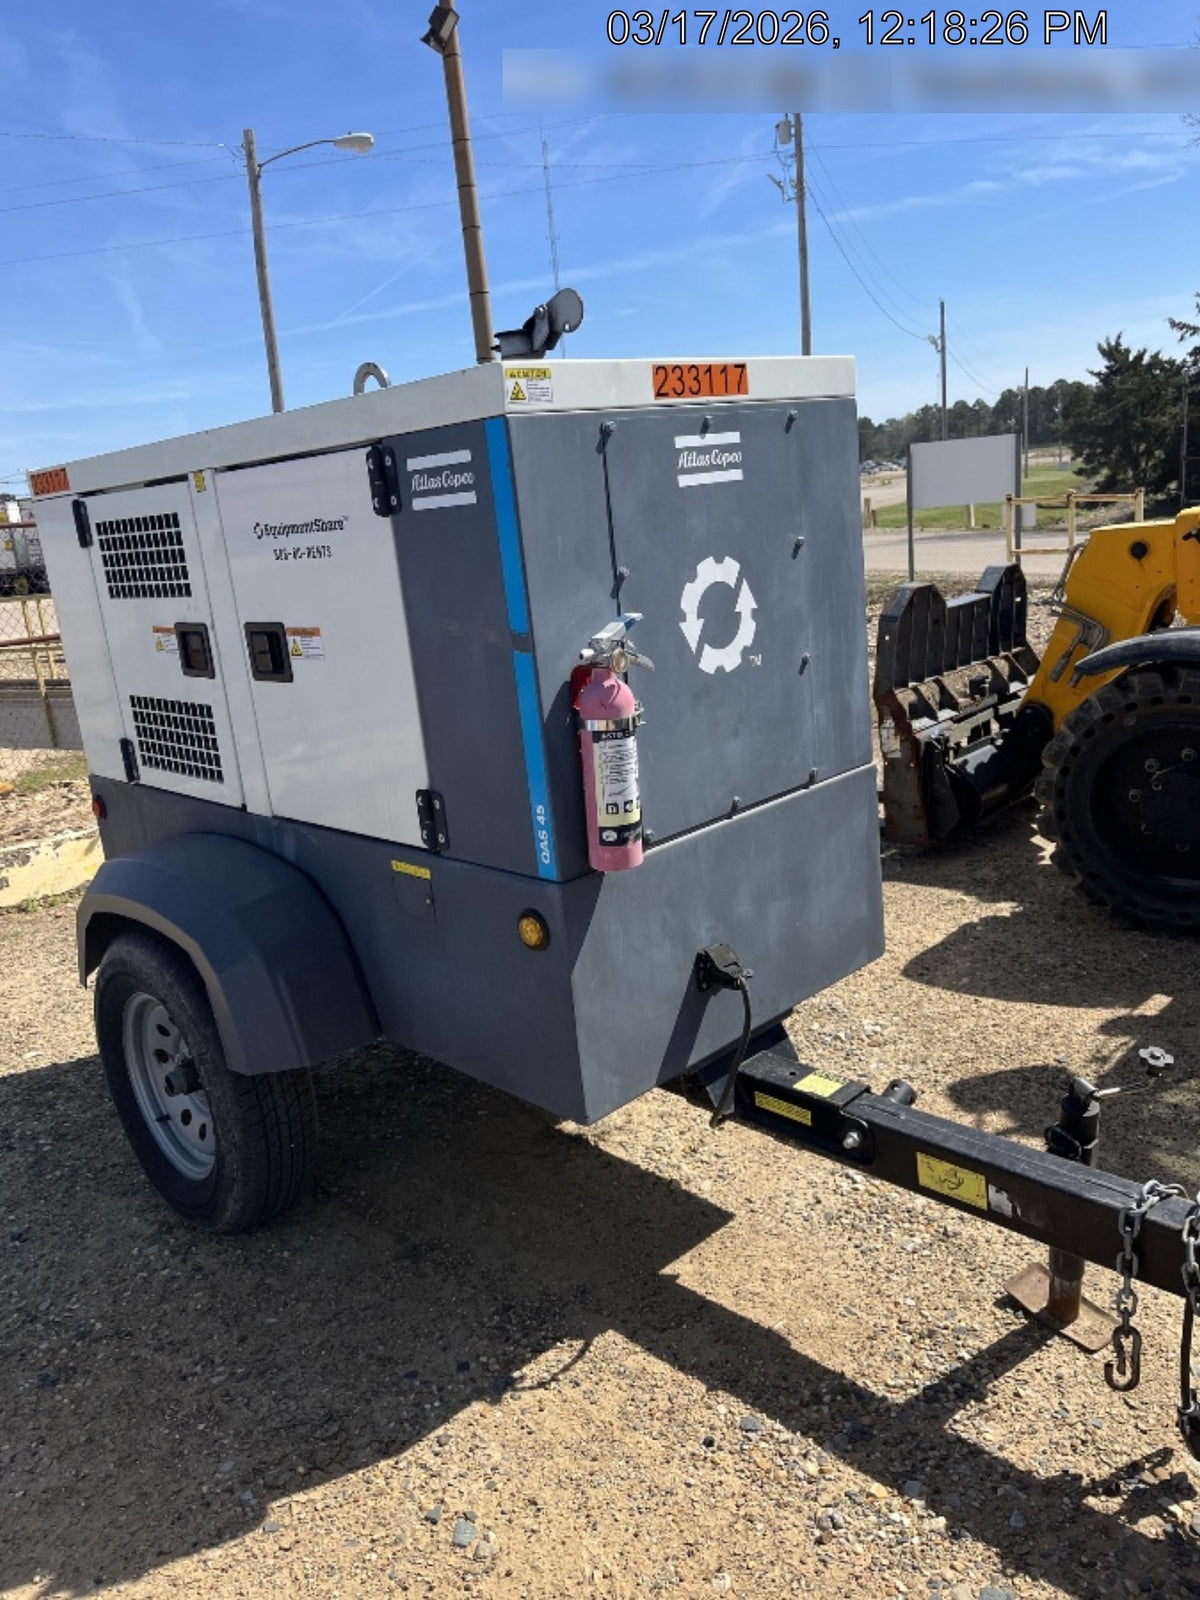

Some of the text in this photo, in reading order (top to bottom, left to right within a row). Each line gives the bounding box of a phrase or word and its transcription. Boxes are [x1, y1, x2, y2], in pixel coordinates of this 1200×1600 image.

[655, 364, 746, 397] 233117
[678, 449, 742, 469] Atlas Copco
[411, 471, 475, 492] Atlas Copco
[536, 805, 550, 864] QAS 45
